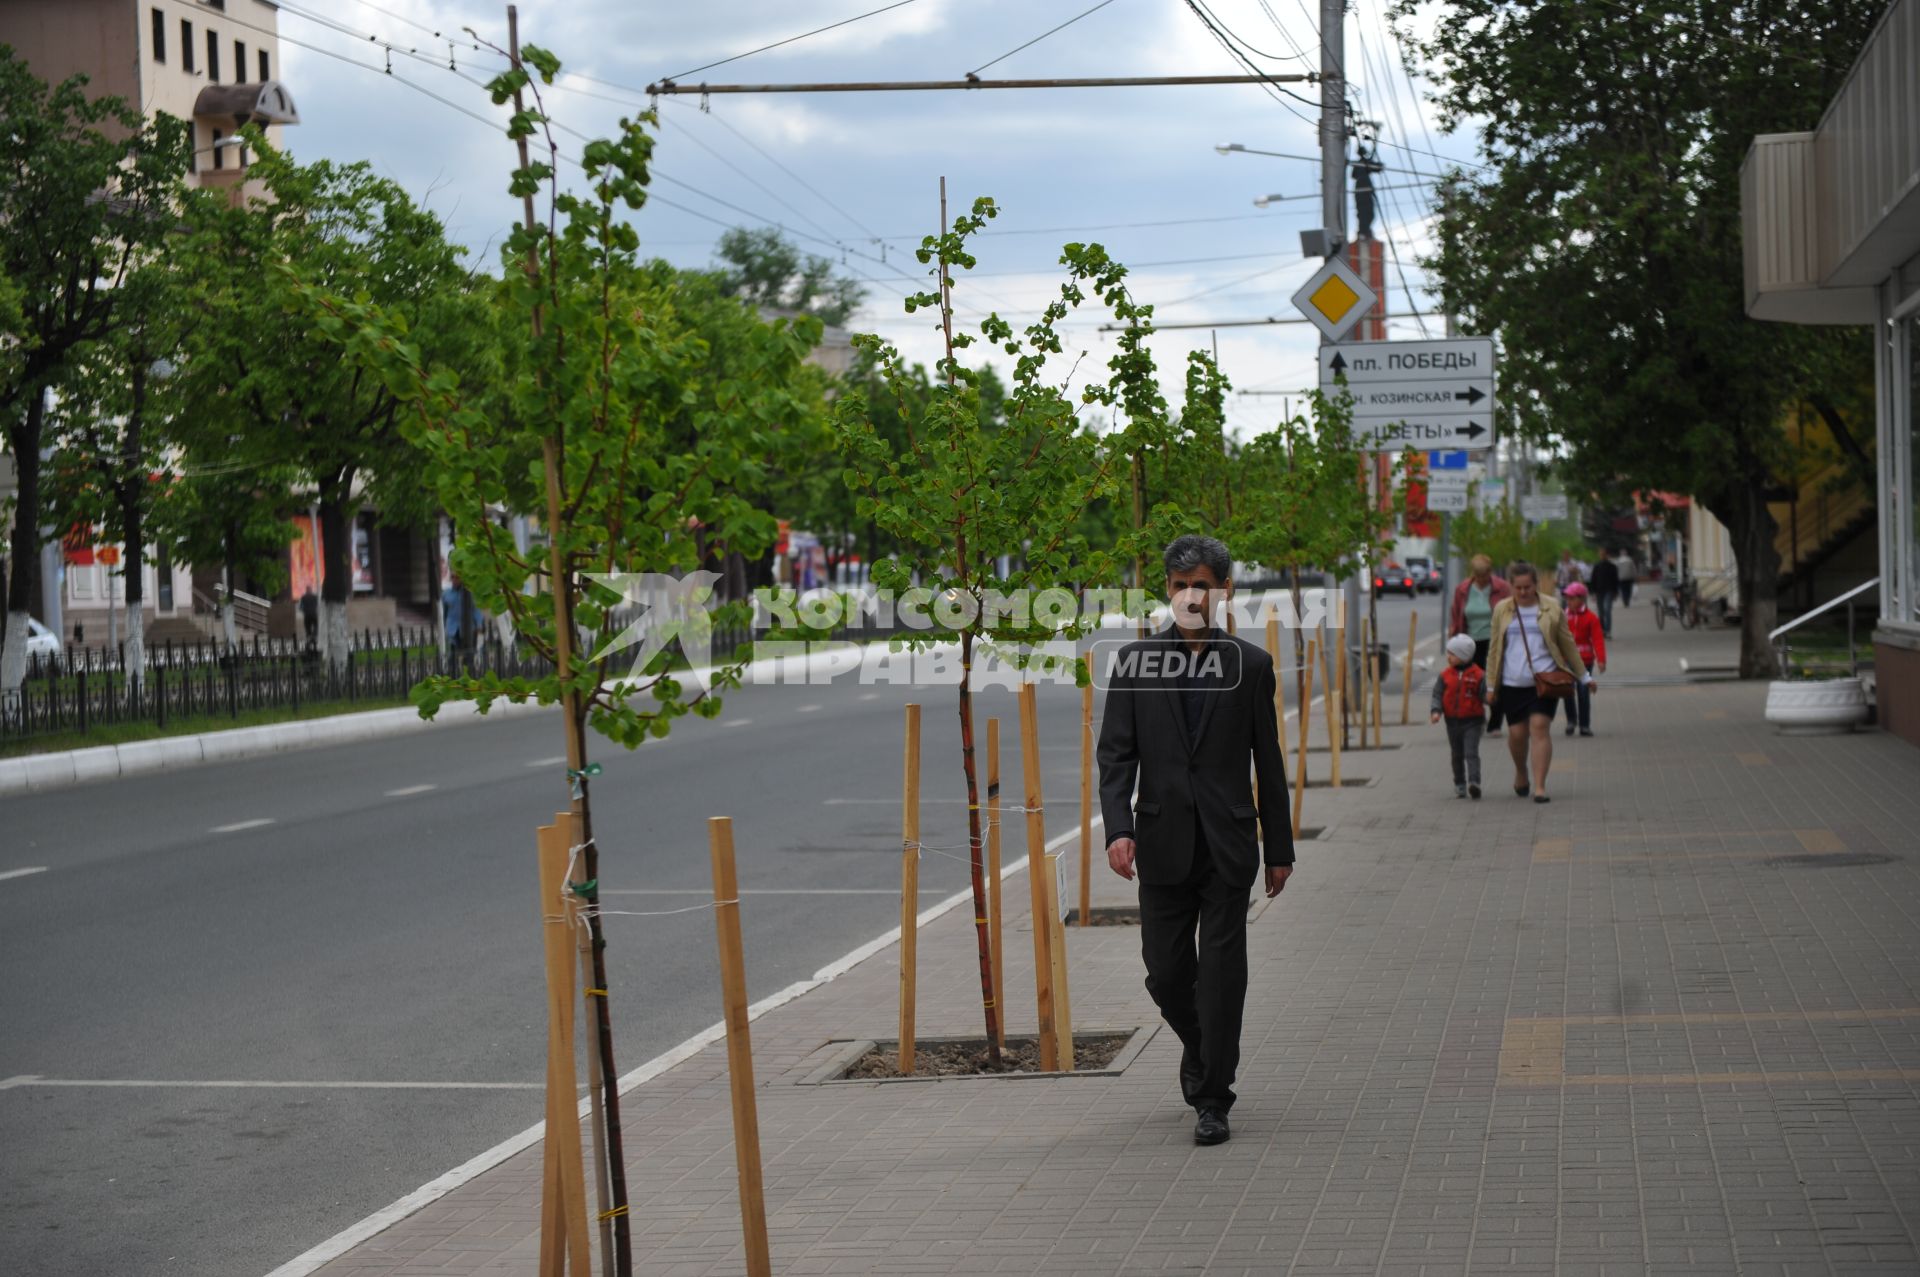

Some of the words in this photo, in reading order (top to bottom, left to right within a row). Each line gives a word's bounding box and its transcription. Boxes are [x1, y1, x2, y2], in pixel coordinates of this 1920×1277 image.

[1353, 358, 1381, 371] пл.
[1388, 352, 1477, 371] ПОБЕДЫ
[1370, 391, 1452, 405] КОЗИНСКАЯ
[1370, 424, 1453, 441] ЦВЕТЫ»
